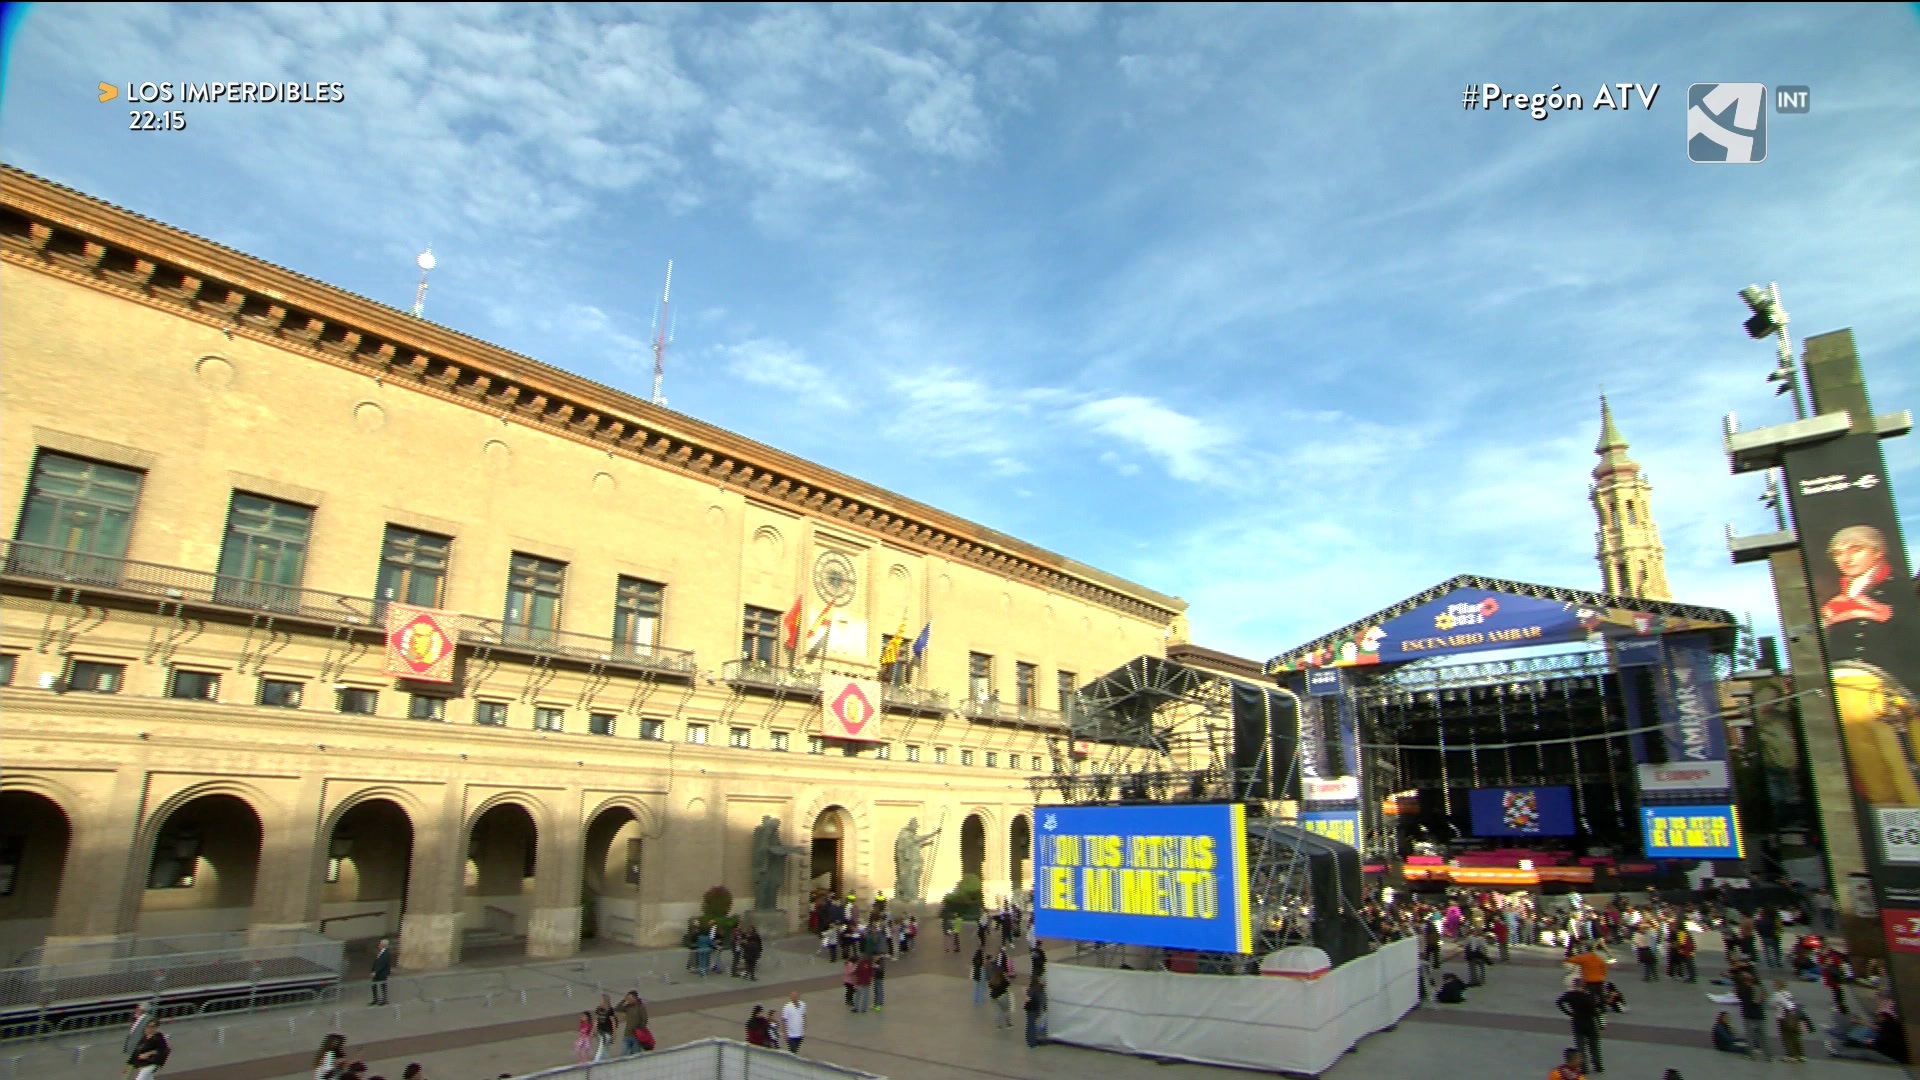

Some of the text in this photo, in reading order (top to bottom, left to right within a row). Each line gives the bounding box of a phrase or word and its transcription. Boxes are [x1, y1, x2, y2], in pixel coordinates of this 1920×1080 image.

[1401, 625, 1543, 652] ESCENARIO AMBAR
[1675, 684, 1708, 760] AMBAR
[1083, 835, 1125, 869] TUS
[1126, 835, 1218, 871] ARTISTAS
[1040, 866, 1219, 920] DEL MOMENTO
